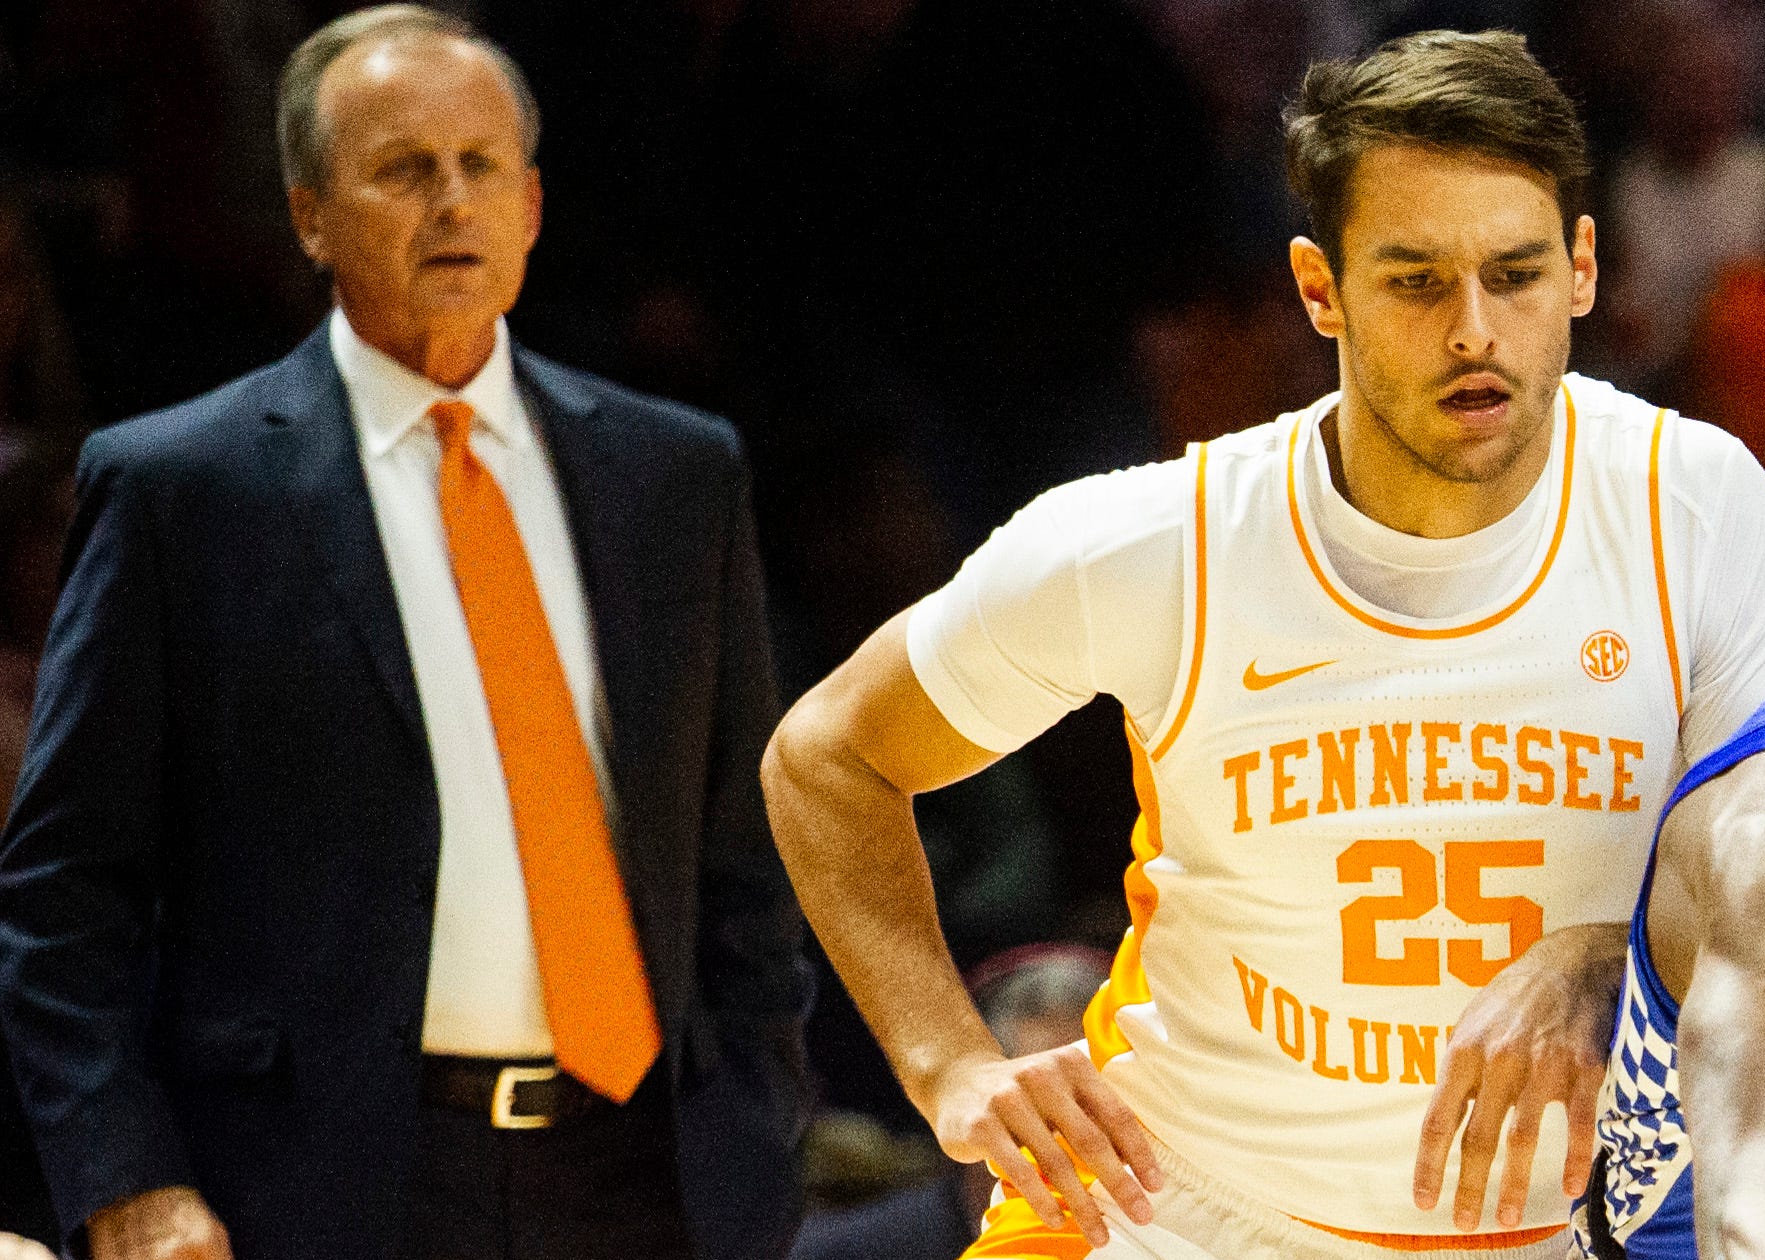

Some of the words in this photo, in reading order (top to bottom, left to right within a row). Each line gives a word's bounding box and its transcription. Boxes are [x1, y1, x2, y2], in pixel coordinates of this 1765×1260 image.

[1584, 634, 1626, 677] SEC
[1223, 720, 1645, 834] TENNESSEE
[1335, 839, 1545, 988] 25
[1232, 953, 1458, 1086] VOLUN
